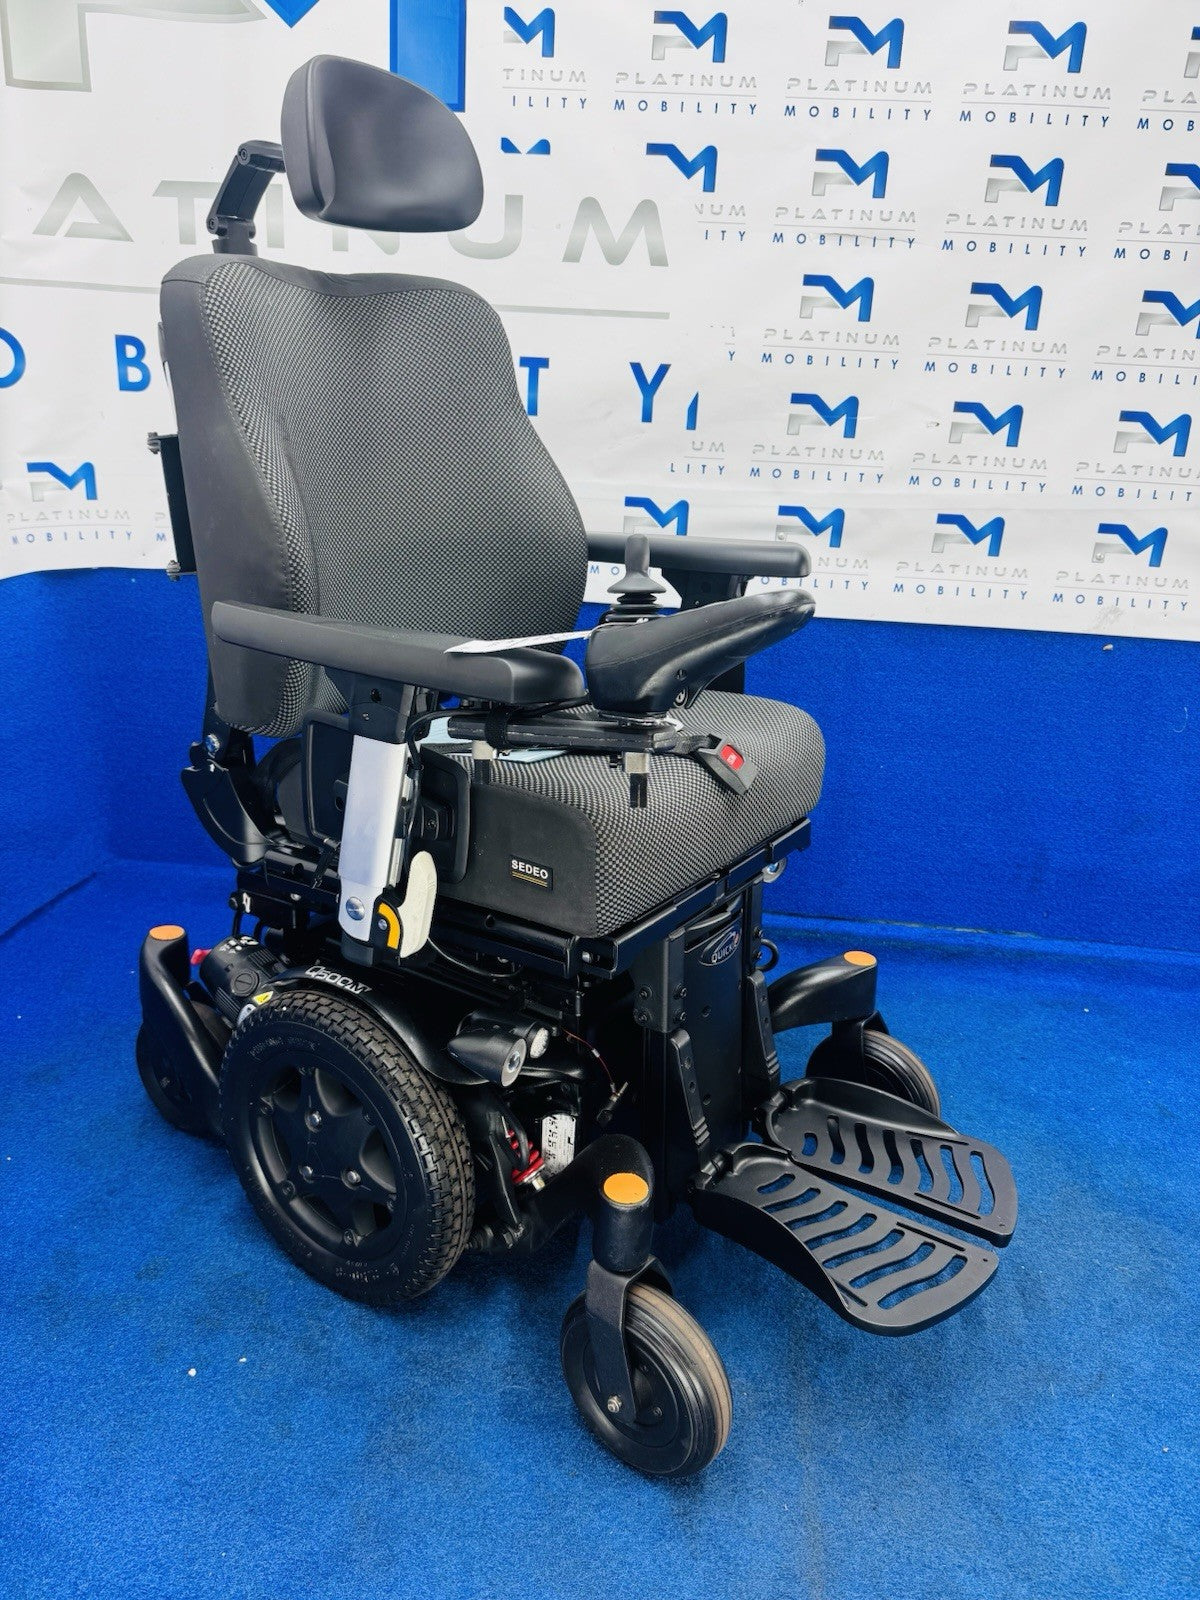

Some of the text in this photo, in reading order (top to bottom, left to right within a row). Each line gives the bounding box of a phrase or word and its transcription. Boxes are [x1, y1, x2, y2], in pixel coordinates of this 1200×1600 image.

[616, 72, 757, 88] PLATINUM
[786, 78, 931, 94] PLATINUM
[962, 83, 1111, 103] PLATINUM
[613, 100, 758, 114] MOBILITY
[784, 105, 932, 119] MOBILITY
[959, 110, 1111, 127] MOBILITY
[774, 207, 916, 225] PLATINUM
[945, 213, 1087, 234] PLATINUM
[704, 229, 747, 240] ITY
[772, 232, 916, 247] MOBILITY
[941, 240, 1089, 256] MOBILITY
[763, 328, 899, 348] PLATINUM
[927, 337, 1067, 356] PLATINUM
[761, 352, 901, 368] MOBILITY
[924, 361, 1068, 377] MOBILITY
[751, 444, 884, 462] PLATINUM
[911, 453, 1047, 472] PLATINUM
[1075, 461, 1200, 479] PLATINU
[749, 467, 884, 482] MOBILITY
[909, 475, 1048, 492] MOBILITY
[896, 561, 1027, 581] PLATINUM
[1055, 571, 1189, 590] PLATINUM
[893, 584, 1028, 599] MOBILITY
[1051, 593, 1190, 609] MOBILITY
[511, 859, 549, 880] SEDEO
